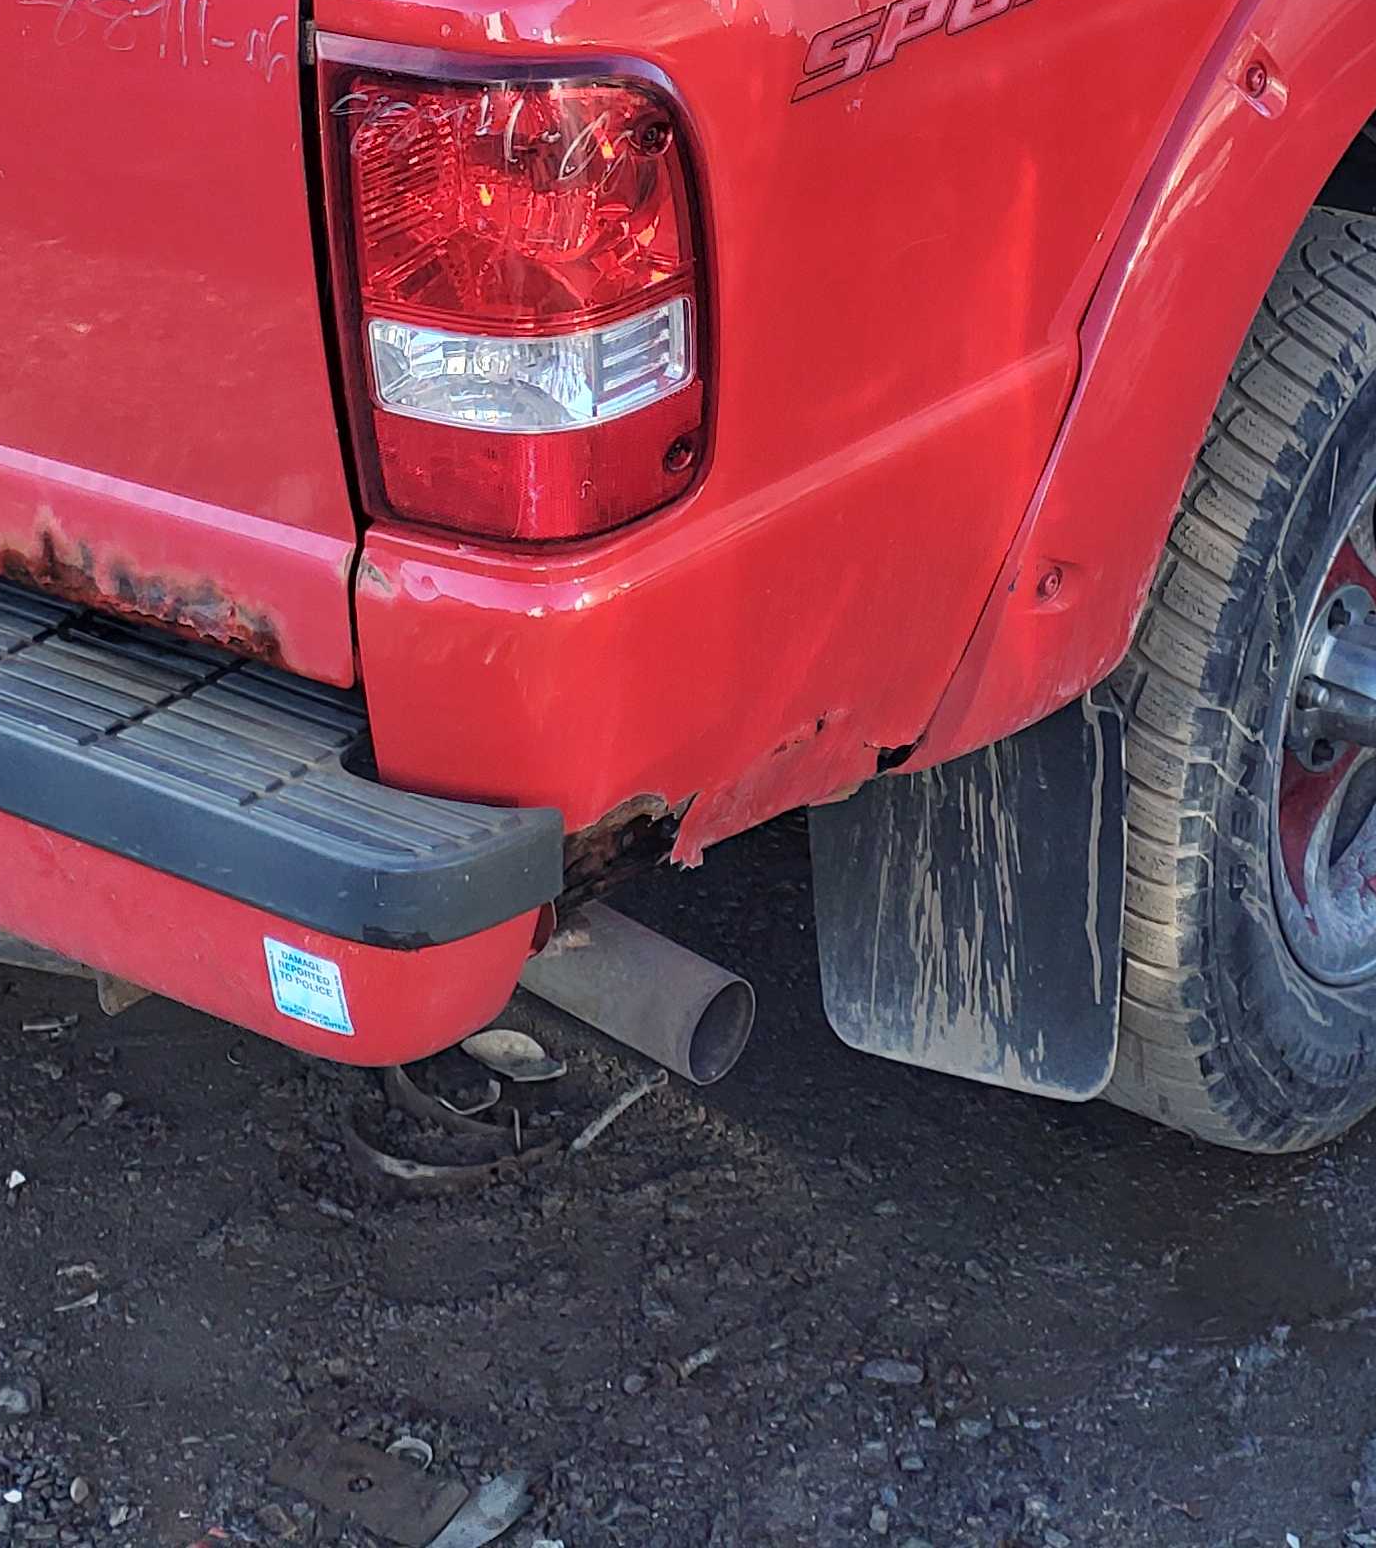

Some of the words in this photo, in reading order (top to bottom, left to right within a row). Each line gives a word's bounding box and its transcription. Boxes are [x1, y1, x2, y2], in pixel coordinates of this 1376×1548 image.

[277, 959, 331, 986] REPORTED
[280, 950, 323, 974] DAMAGE
[279, 969, 293, 983] TO
[296, 976, 335, 998] POLICE
